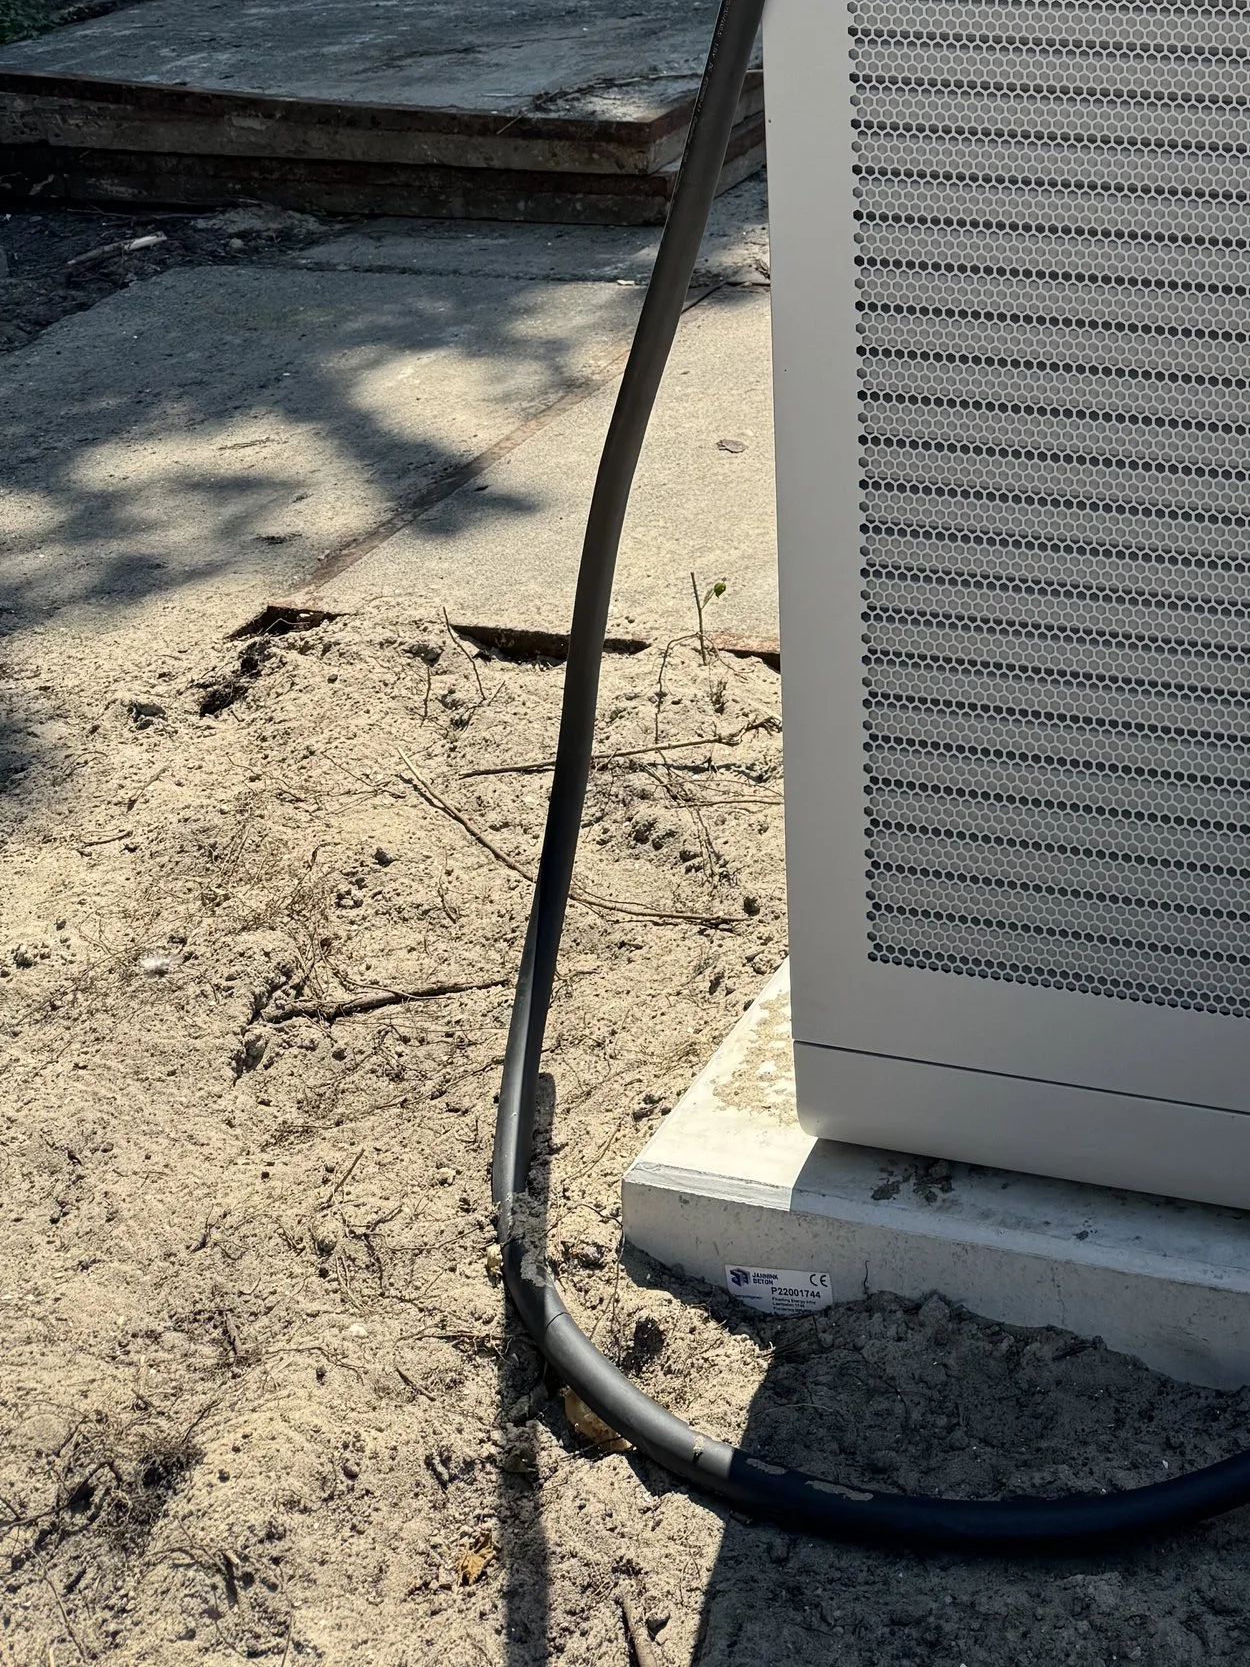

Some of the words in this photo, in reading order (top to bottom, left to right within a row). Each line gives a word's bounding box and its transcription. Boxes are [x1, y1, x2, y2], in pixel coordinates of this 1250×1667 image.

[753, 1278, 774, 1286] BETON
[809, 1273, 828, 1288] CE
[771, 1287, 821, 1299] P22001744
